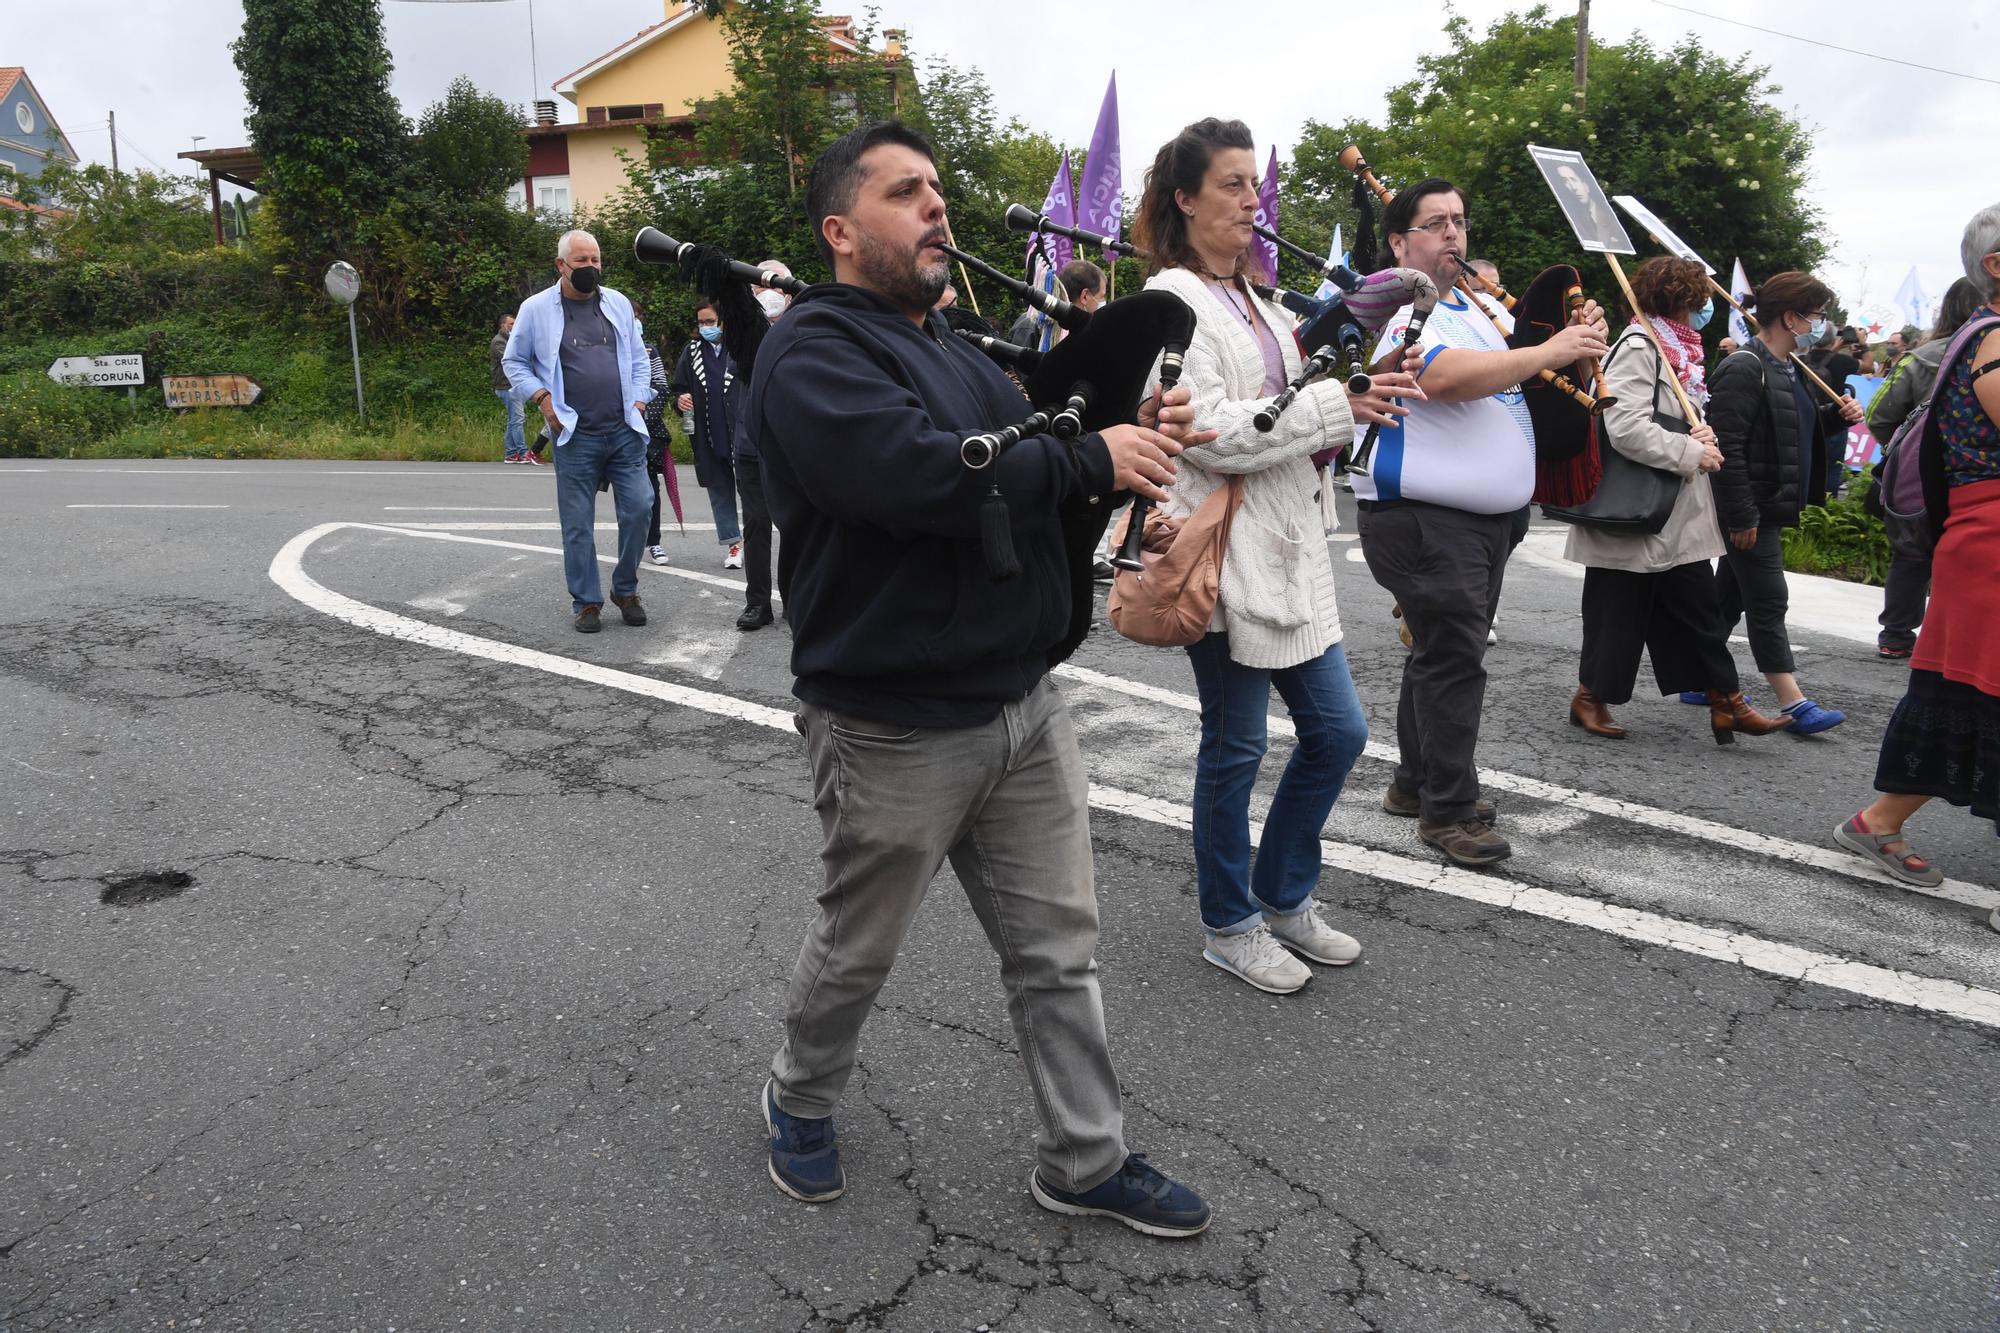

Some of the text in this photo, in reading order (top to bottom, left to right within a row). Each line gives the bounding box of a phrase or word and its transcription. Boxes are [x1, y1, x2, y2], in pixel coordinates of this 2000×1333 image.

[114, 358, 139, 366] CRUZ
[93, 371, 140, 382] CORUÑA
[170, 380, 198, 389] PAZO
